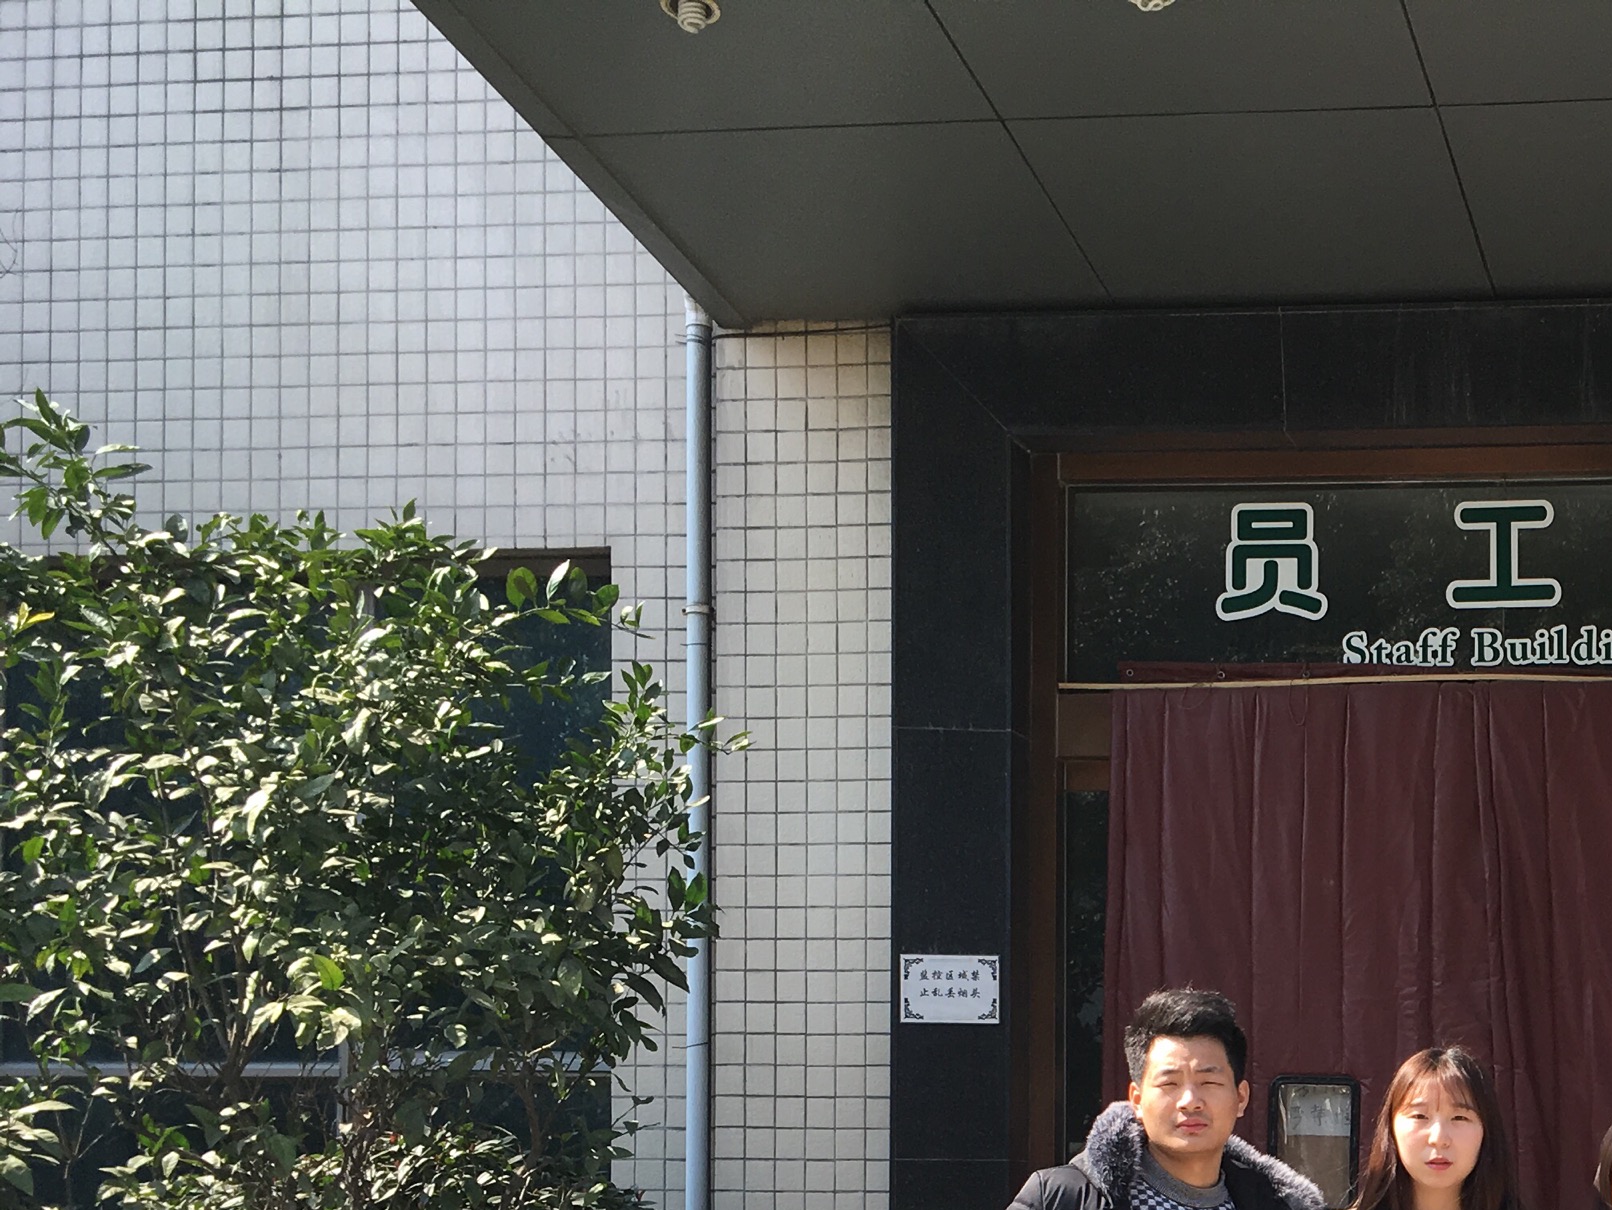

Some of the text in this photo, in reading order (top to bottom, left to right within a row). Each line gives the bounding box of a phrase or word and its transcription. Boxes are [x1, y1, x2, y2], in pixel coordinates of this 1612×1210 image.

[1341, 626, 1460, 666] Staff
[919, 968, 981, 981] 监控区域禁
[919, 986, 981, 999] 止乱丢烟头
